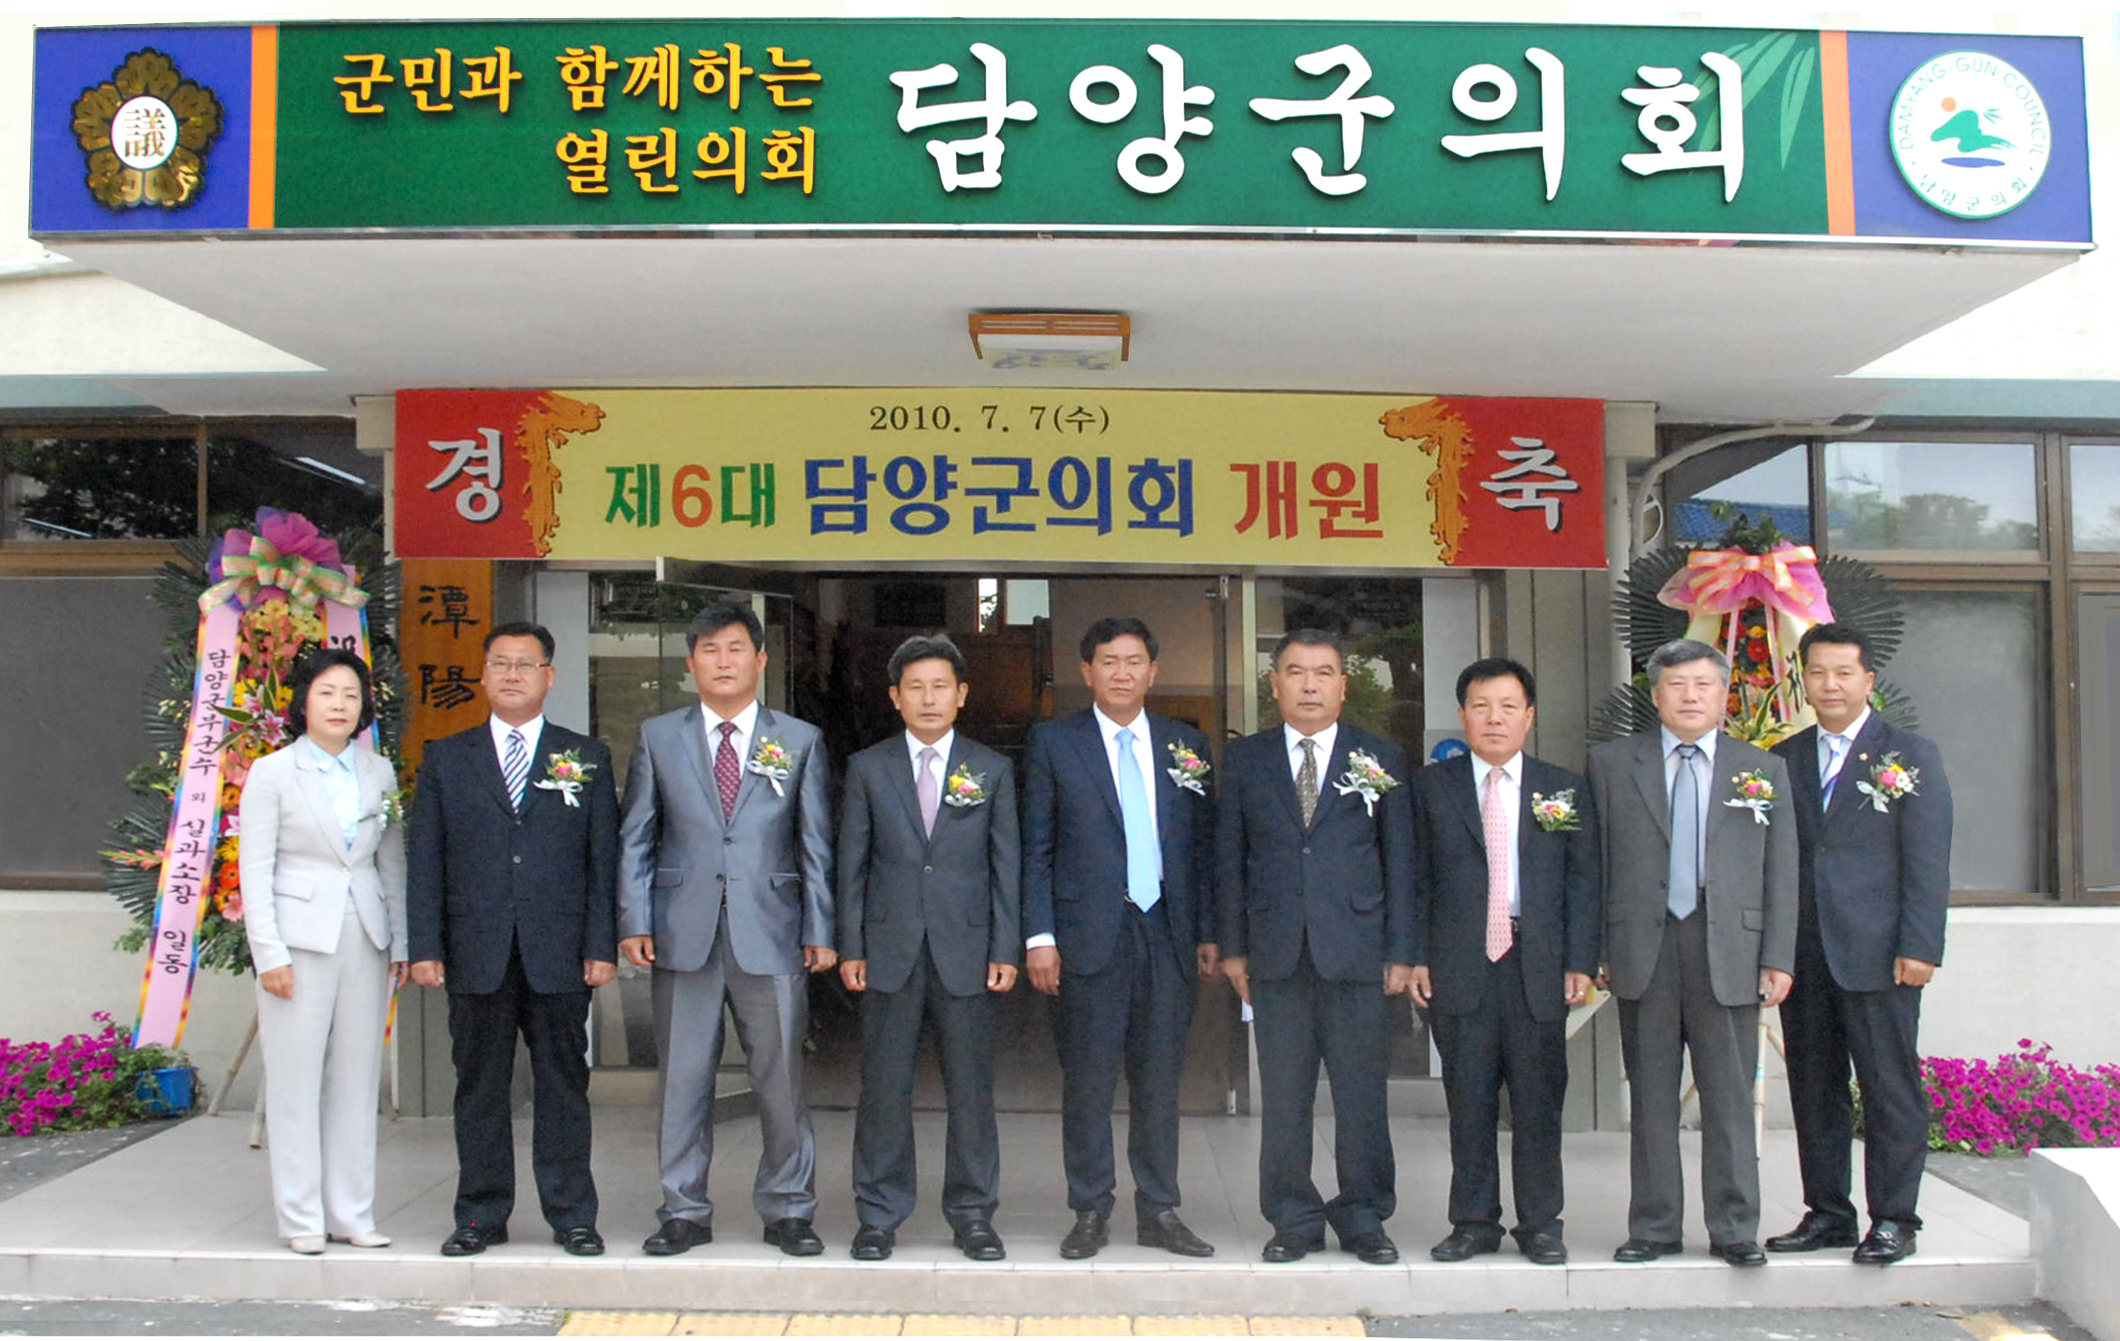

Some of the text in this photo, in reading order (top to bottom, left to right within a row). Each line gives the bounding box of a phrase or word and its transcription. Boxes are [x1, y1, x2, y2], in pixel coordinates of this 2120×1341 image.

[333, 43, 822, 113] 군민과 함께하는
[1898, 57, 2046, 155] DAMYANG-GUN COUNCIL
[124, 107, 166, 157] 議
[556, 127, 816, 195] 열린의회
[889, 42, 1744, 203] 담양군의회
[869, 404, 1110, 435] 2010. 7. 7(수)
[425, 427, 503, 522] 경
[604, 454, 1385, 540] 제6대 담양군의회 개원
[1479, 436, 1580, 532] 축
[157, 930, 189, 974] 일동
